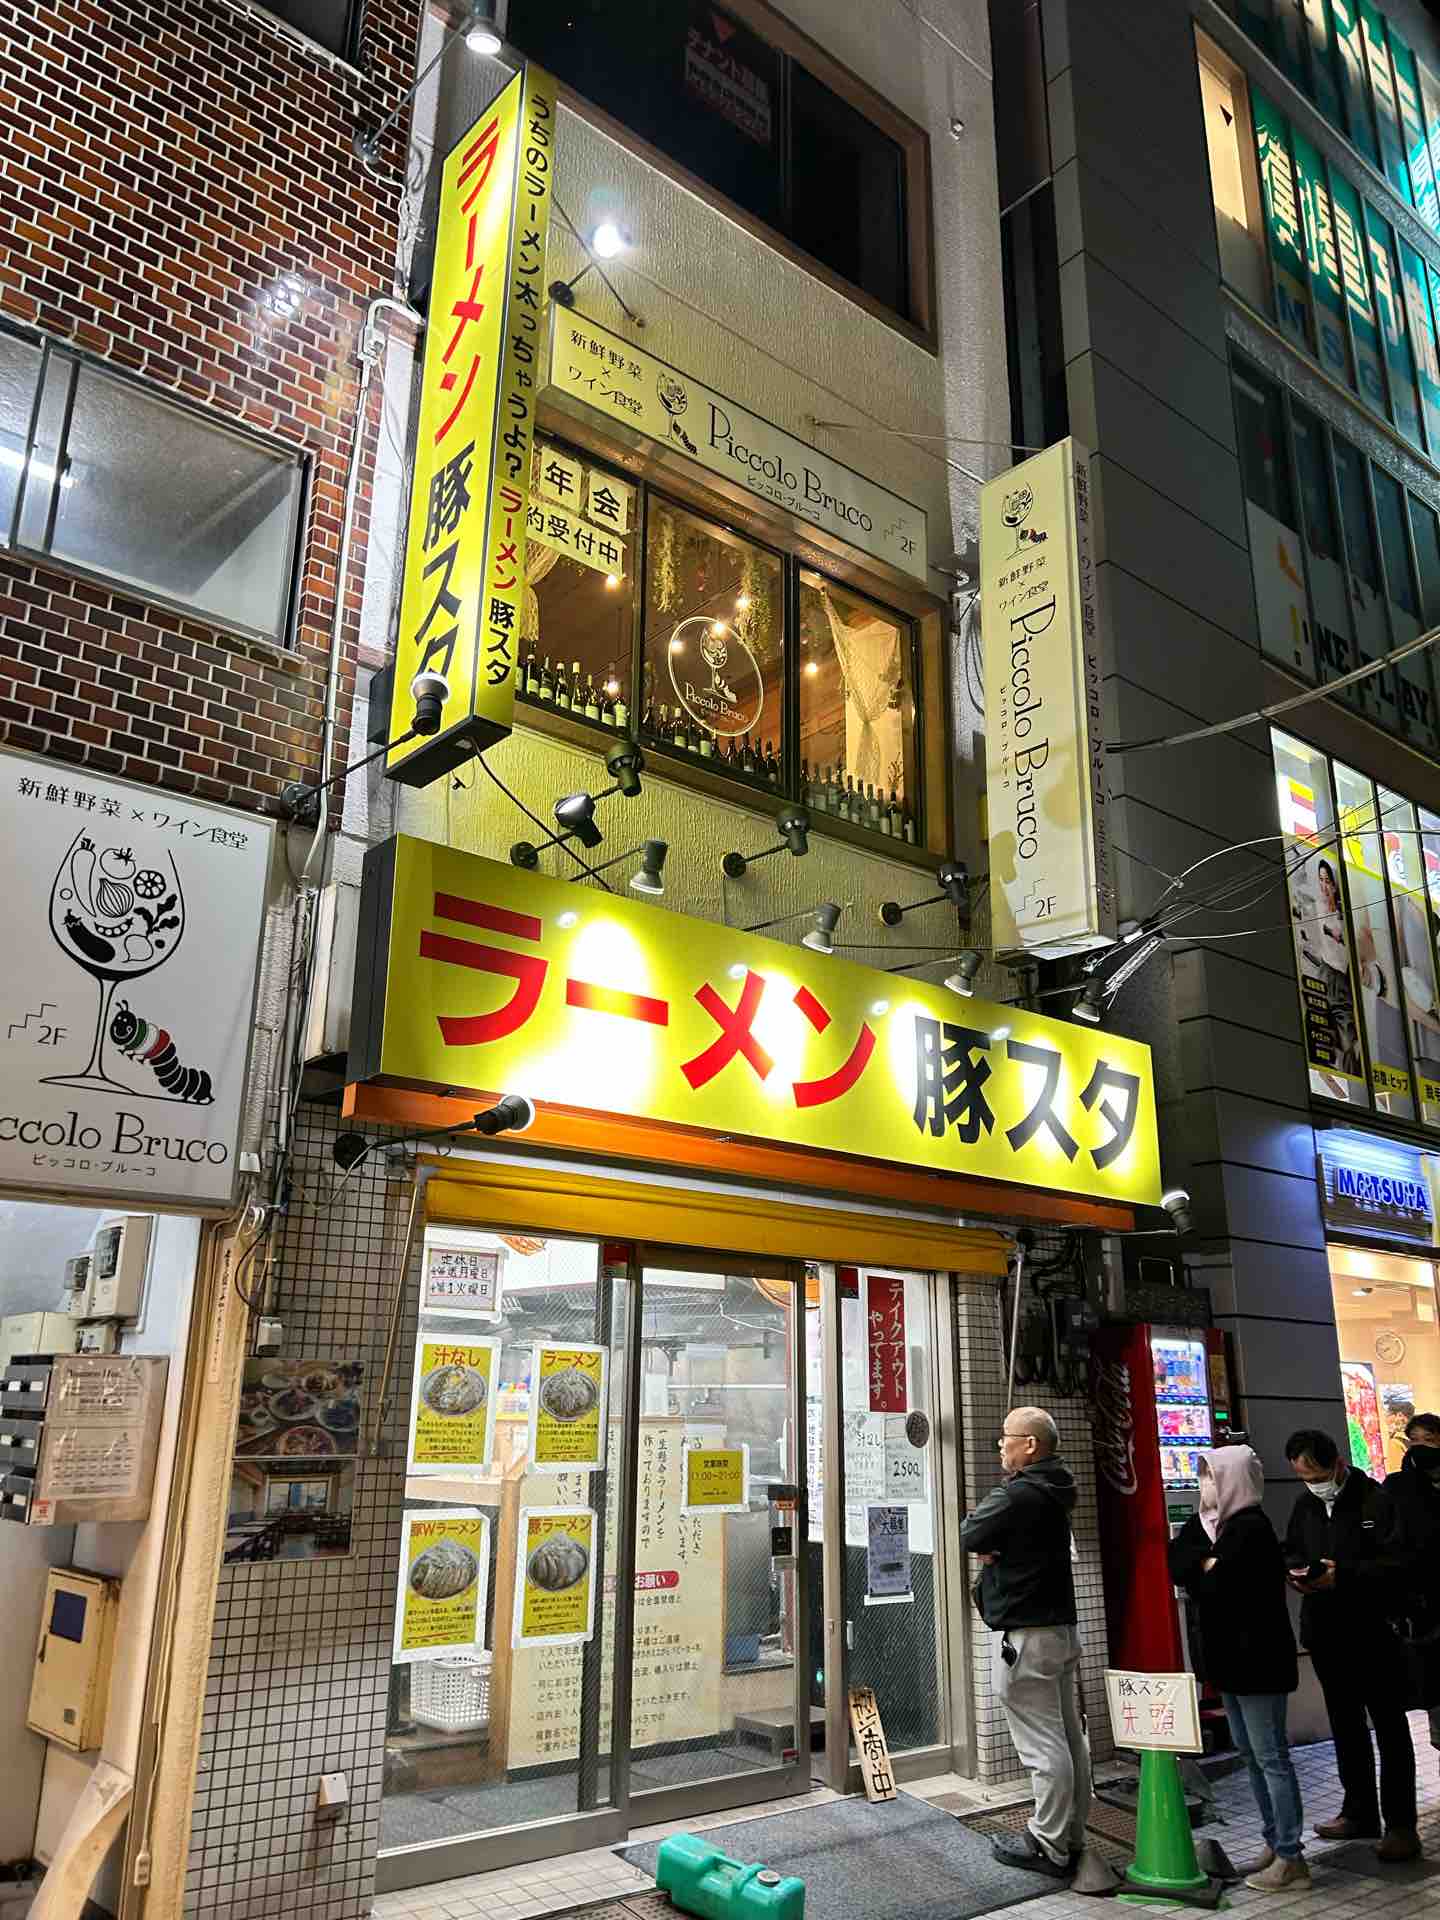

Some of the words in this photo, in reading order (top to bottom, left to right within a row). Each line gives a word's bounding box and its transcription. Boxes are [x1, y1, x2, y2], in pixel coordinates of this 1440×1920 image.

[434, 116, 500, 445] ラーメン
[569, 328, 643, 382] 新鮮野菜
[567, 365, 645, 417] ワイン食堂
[707, 401, 798, 492] Piccolo
[802, 467, 873, 533] Bruco
[492, 489, 522, 590] ラーメン
[899, 535, 917, 557] 2F
[486, 597, 515, 686] 豚スタ
[1010, 595, 1056, 738] Piccolo
[1015, 738, 1050, 860] Bruco
[1035, 896, 1057, 918] 2F
[38, 1025, 69, 1046] 2F
[419, 892, 877, 1108] ラーメン
[912, 1014, 1141, 1171] 豚スタ
[111, 1112, 229, 1165] Bruco
[441, 1252, 478, 1267] 定休日
[433, 1347, 480, 1367] 汁なし
[543, 1351, 599, 1368] ラーメン
[889, 1282, 905, 1399] テイクアウト
